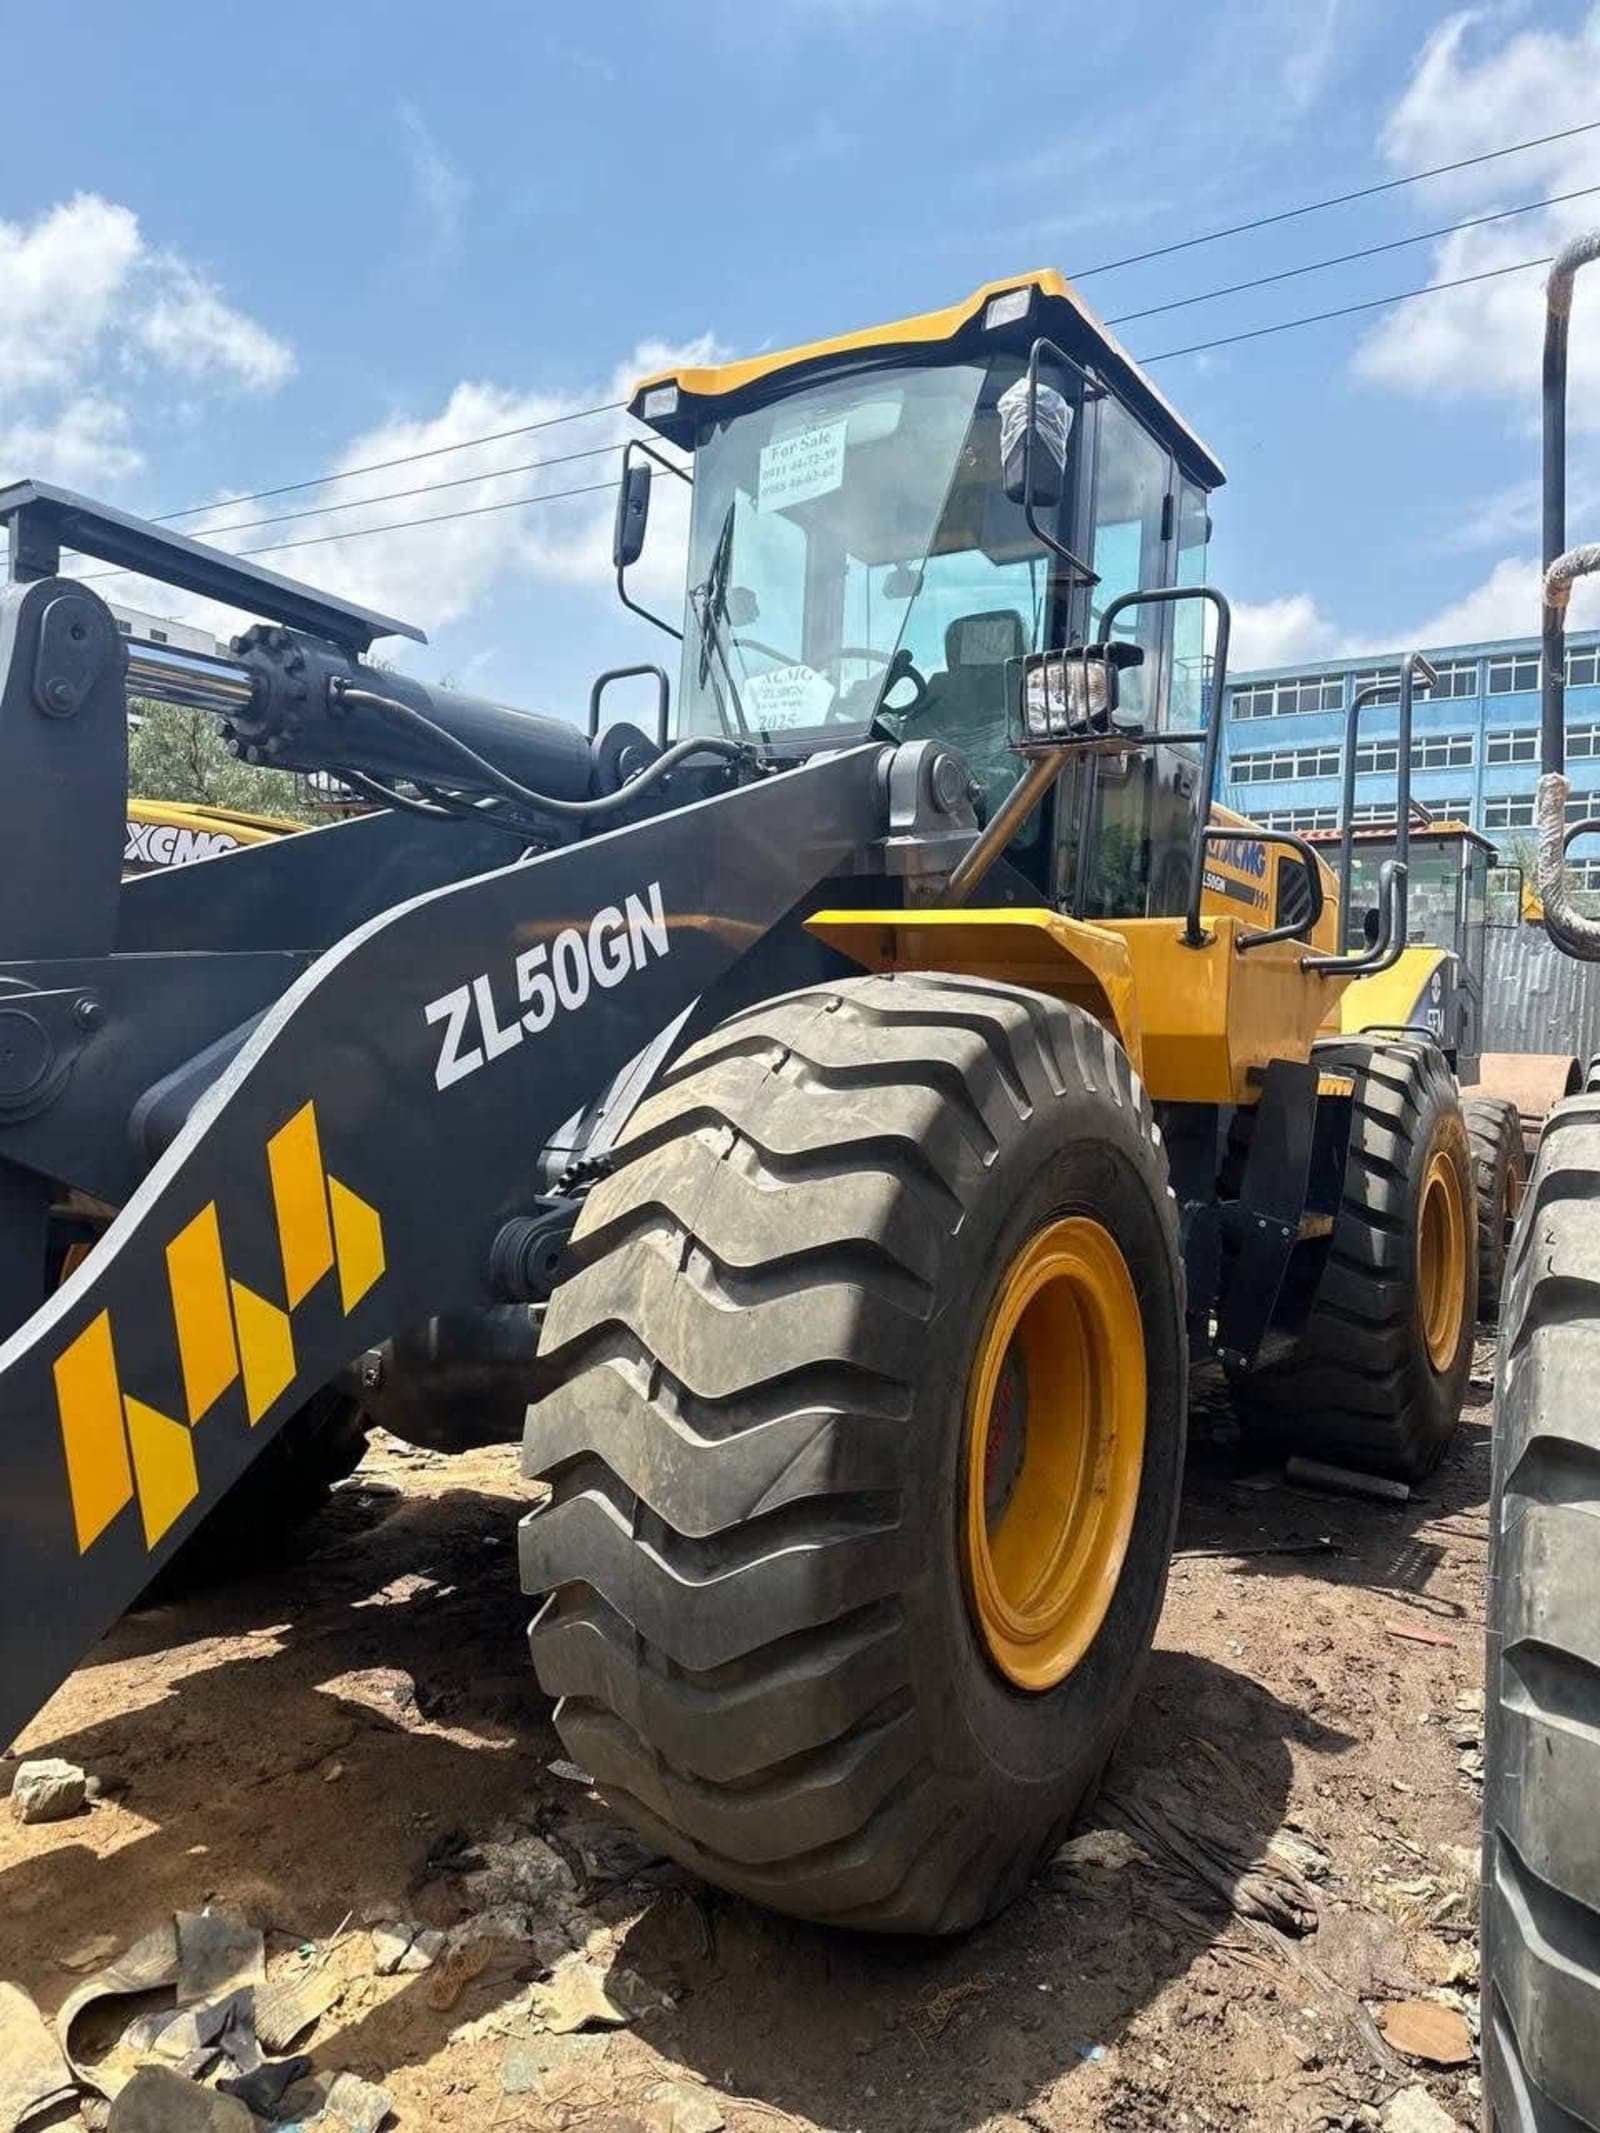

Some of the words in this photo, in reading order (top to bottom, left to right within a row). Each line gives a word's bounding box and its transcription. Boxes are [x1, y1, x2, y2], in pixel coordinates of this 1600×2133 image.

[772, 443, 797, 461] For
[800, 431, 830, 451] Sale
[424, 881, 669, 1091] ZL50GN
